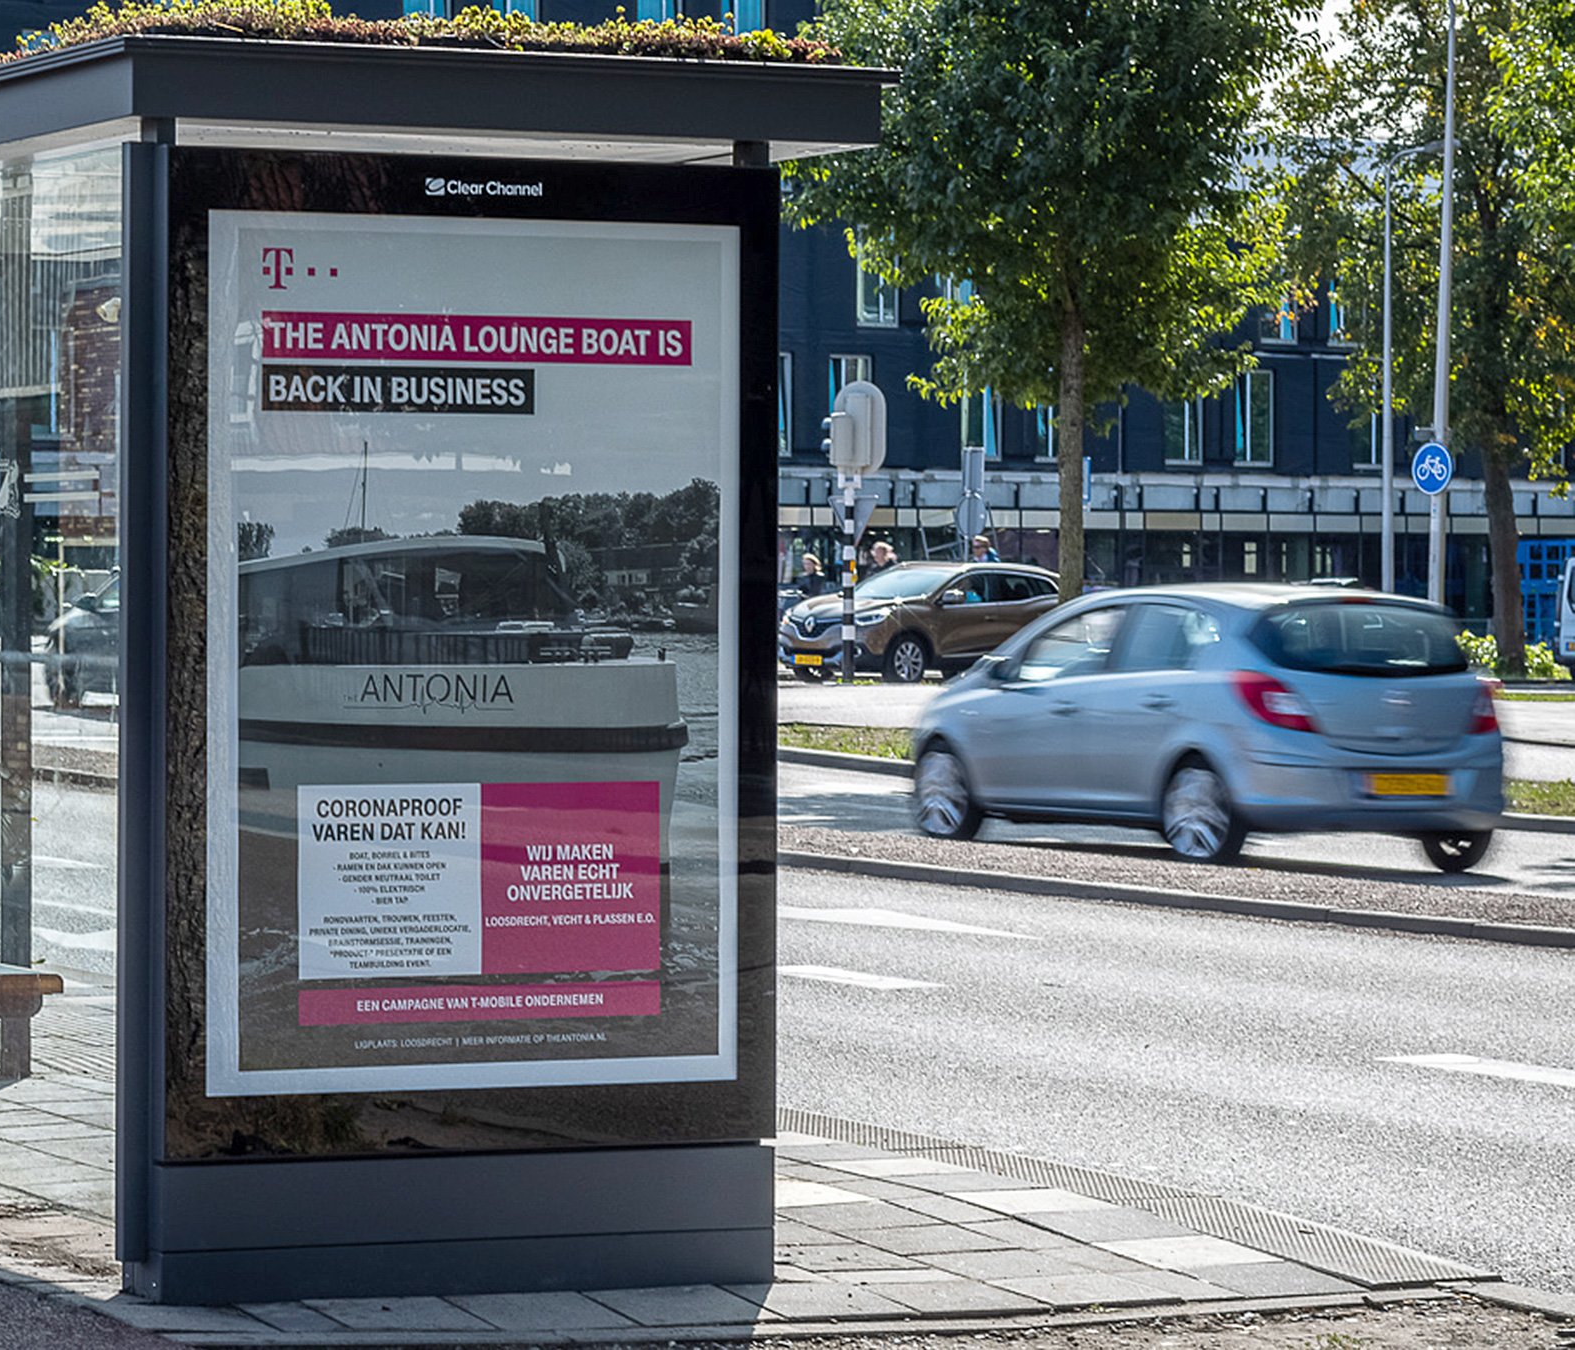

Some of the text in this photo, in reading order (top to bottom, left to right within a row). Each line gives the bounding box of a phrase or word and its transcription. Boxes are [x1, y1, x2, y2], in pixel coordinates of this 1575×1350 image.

[446, 180, 543, 196] Clear Channel
[268, 321, 684, 357] THE ANTONIA LOUNGE BOAT IS
[268, 374, 526, 406] BACK IN BUSINESS
[360, 673, 514, 704] ANTONIA
[316, 798, 463, 819] CORONAPROOF
[312, 821, 467, 842] VAREN DAT KAN!
[371, 851, 401, 860] BORREL
[409, 850, 431, 859] BITES
[526, 843, 614, 862] WIJ MAKEN
[336, 863, 364, 872] RAMEN
[365, 863, 375, 871] EN
[376, 863, 392, 871] DAK
[393, 862, 425, 871] KUNNEN
[425, 862, 446, 870] OPEN
[520, 863, 620, 881] VAREN ECHT
[342, 874, 373, 883] GENDER
[374, 874, 413, 882] NEUTRAAL
[415, 873, 441, 882] TOILET
[379, 885, 425, 894] ELEKTRISCH
[506, 882, 634, 901] ONVERGETELIJK
[375, 897, 393, 905] BIER
[394, 896, 409, 904] TAP
[485, 912, 656, 928] LOOSDRECHT, VECHT & PLASSEN E.O.
[309, 928, 339, 937] PRIVATE
[369, 926, 397, 935] UNIEKE
[375, 948, 423, 957] PRESENTATIE
[425, 948, 434, 956] OF
[436, 948, 452, 956] EEN
[349, 961, 405, 969] TEAMBUILDING
[356, 993, 604, 1012] EEN CAMPAGNE VAN T-MOBILE ONDERNEMEN
[400, 1038, 453, 1048] LOOSDRECHT
[462, 1036, 484, 1046] MEER
[485, 1035, 531, 1045] INFORMATIE
[532, 1034, 545, 1044] OP
[545, 1032, 607, 1043] THEANTONIA.NL
